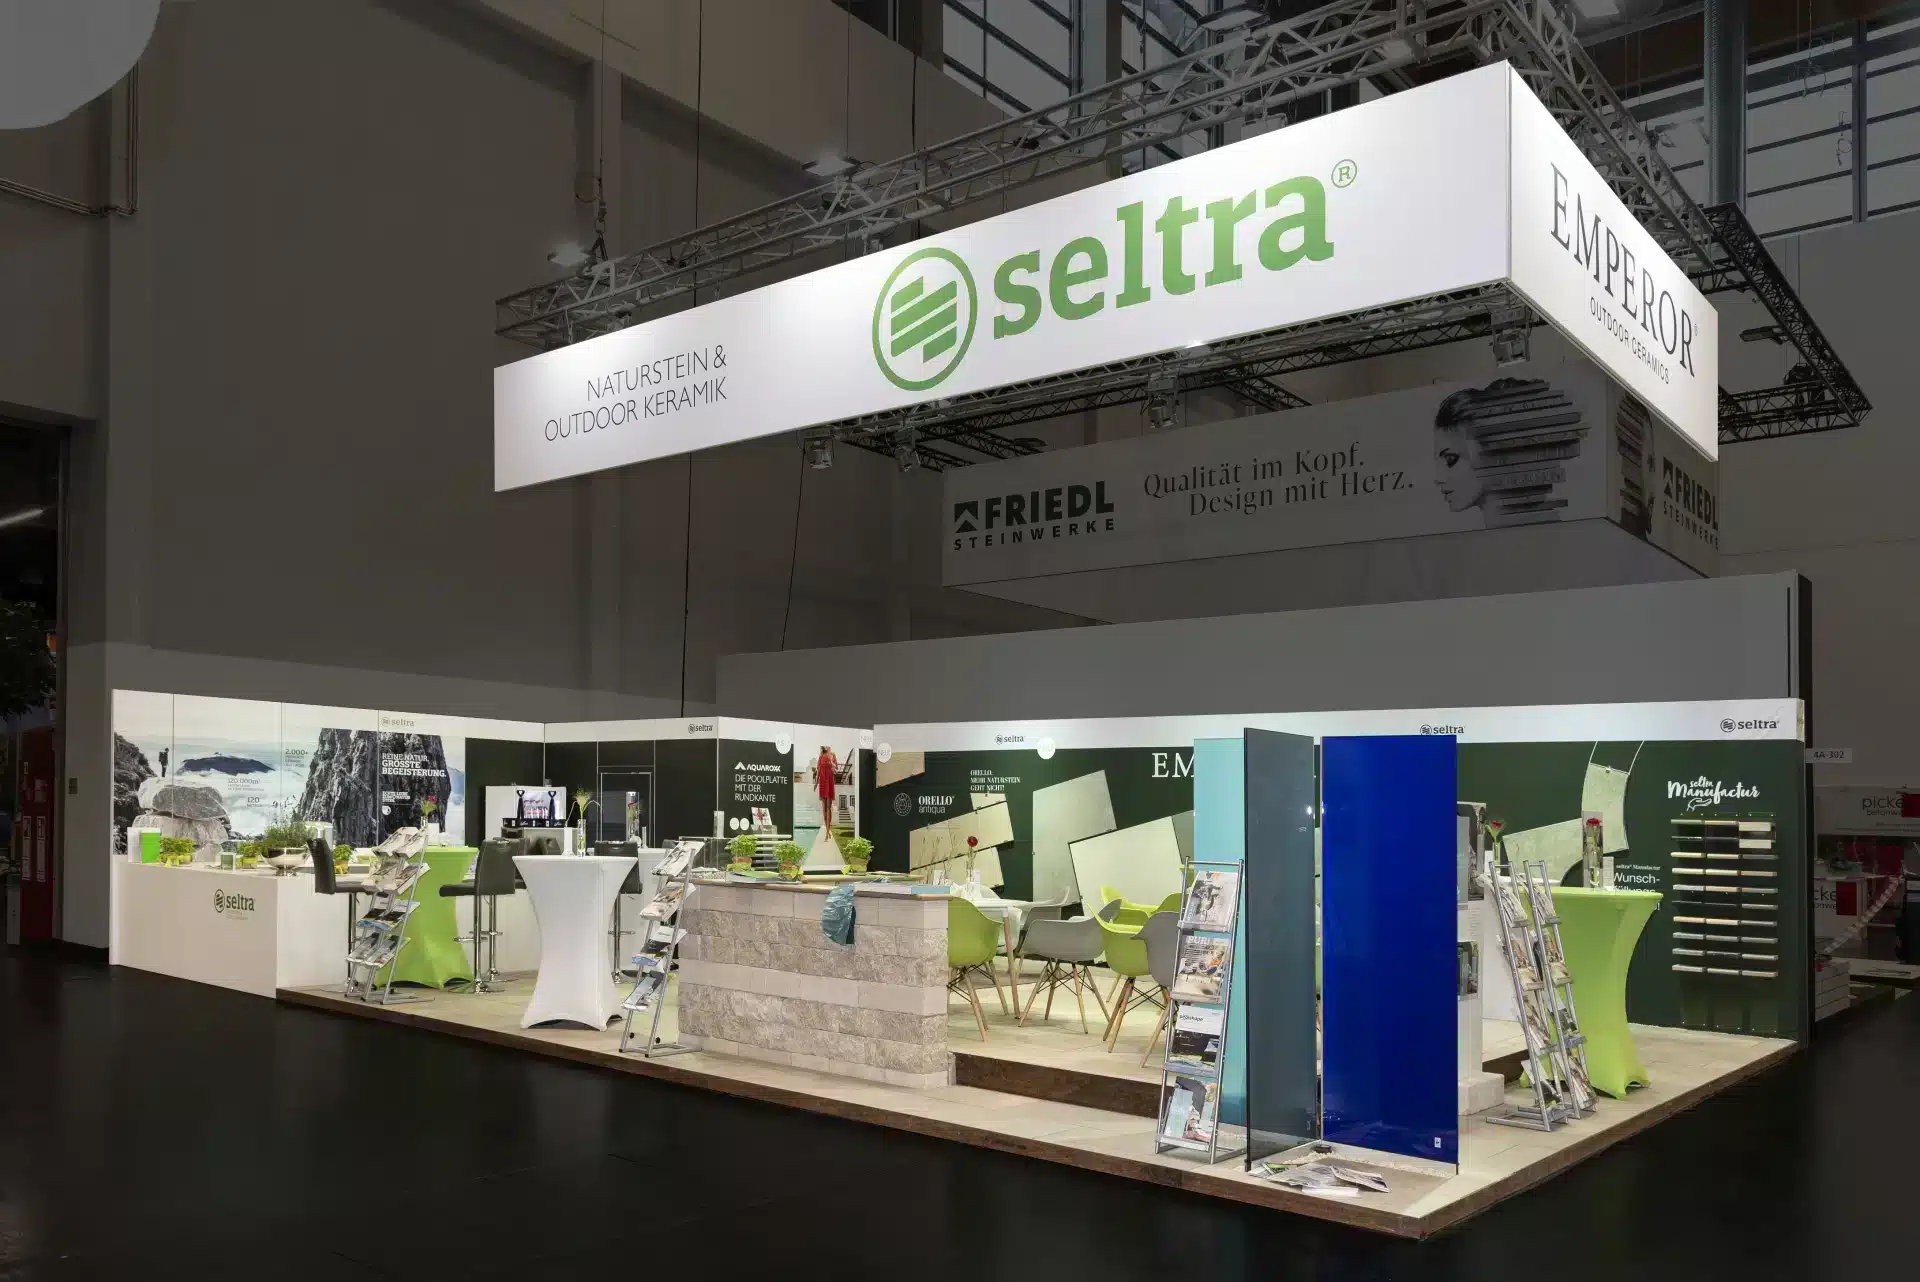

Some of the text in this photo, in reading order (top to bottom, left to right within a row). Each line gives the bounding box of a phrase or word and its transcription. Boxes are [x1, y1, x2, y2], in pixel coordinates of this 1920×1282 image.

[1590, 297, 1671, 384] OUTDOOR CERAMICS
[587, 344, 727, 402] NATURSTEIN &
[544, 376, 727, 441] OUTDOOR KERAMIK
[1143, 441, 1365, 499] Qualität im Kopf.
[1189, 470, 1415, 517] Design mit Herz.
[1675, 466, 1718, 531] FRIEDL
[984, 480, 1115, 530] FRIEDL
[1663, 501, 1719, 551] STEINWERKE
[954, 518, 1115, 551] STEINWERKE
[391, 718, 415, 727] seltra
[695, 724, 713, 732] seltra
[1737, 719, 1777, 730] seltra
[1433, 725, 1465, 734] seltra
[1003, 735, 1024, 743] seltra
[381, 752, 403, 761] REINE
[1813, 750, 1845, 759] 4A-302
[381, 767, 447, 777] BEGEISTERUNG.
[735, 774, 788, 785] DIE POOLPLATTE
[987, 776, 1021, 784] NATURSTEIN
[735, 783, 762, 793] MIT DER
[1667, 780, 1761, 805] Manufactur
[247, 796, 260, 804] 120
[734, 792, 776, 803] RUNDKANTE
[918, 805, 946, 815] antiqua
[225, 893, 255, 912] seltra
